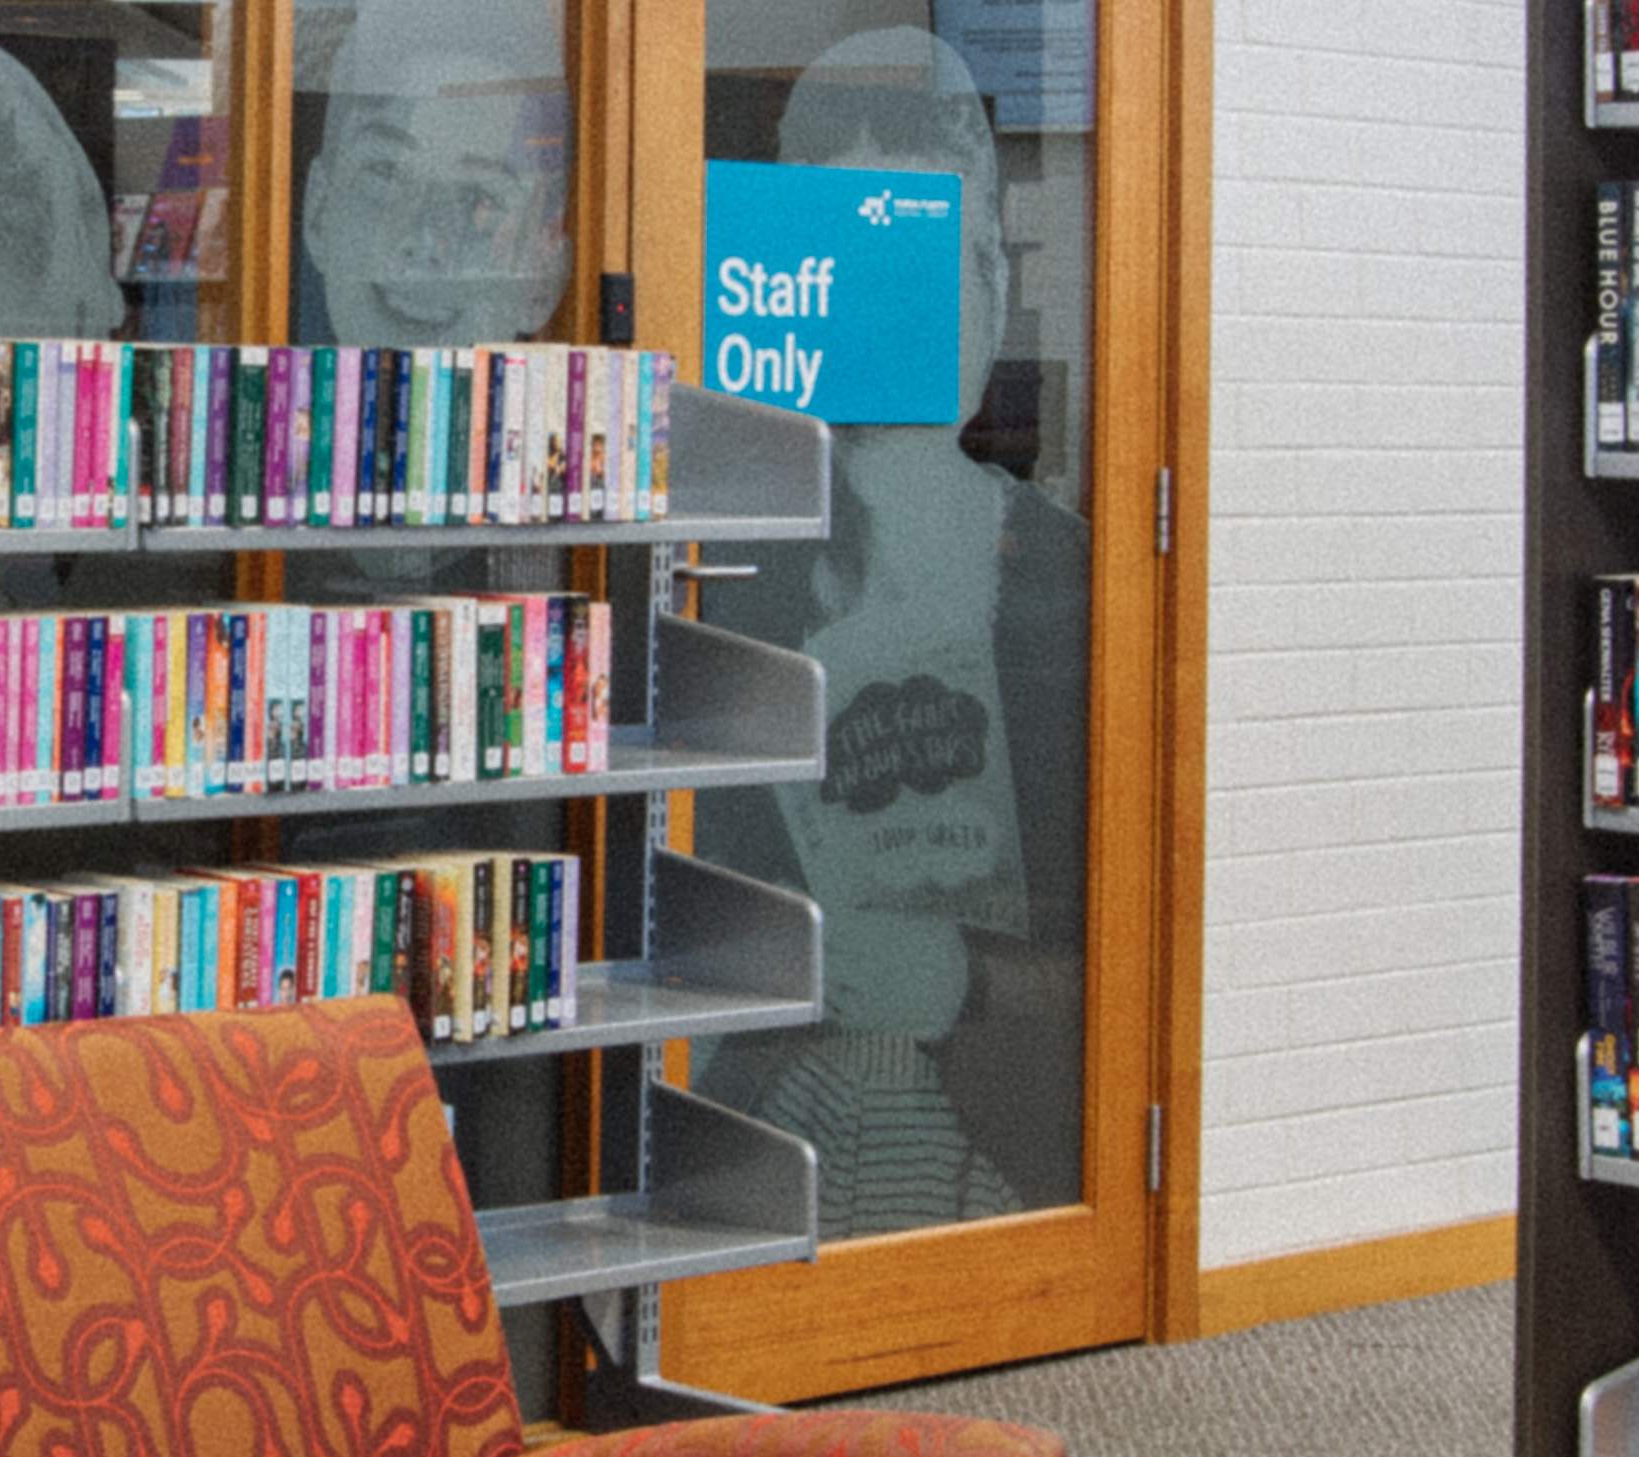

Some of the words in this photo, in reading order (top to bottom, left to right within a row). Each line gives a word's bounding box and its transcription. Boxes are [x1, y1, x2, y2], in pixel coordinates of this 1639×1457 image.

[1599, 200, 1618, 261] BLUE
[716, 256, 835, 318] Staff
[1598, 269, 1618, 346] HOUR
[715, 332, 824, 409] Only
